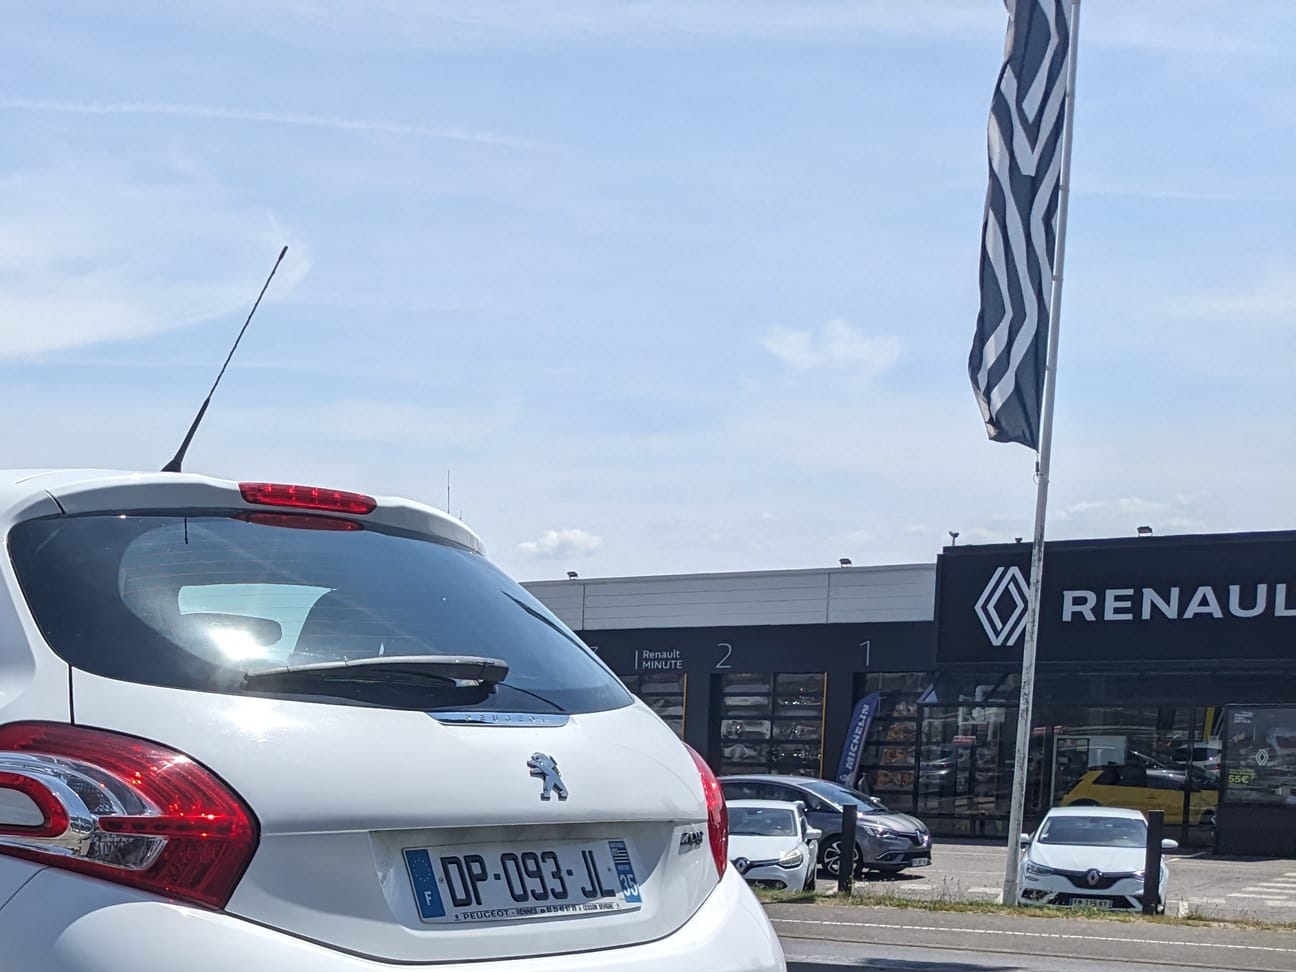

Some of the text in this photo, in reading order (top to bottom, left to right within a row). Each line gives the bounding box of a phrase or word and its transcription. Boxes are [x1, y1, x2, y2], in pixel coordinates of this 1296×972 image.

[642, 650, 680, 659] Renault
[716, 643, 732, 668] 2
[860, 640, 870, 666] 1
[642, 660, 683, 669] MINUTE
[845, 704, 870, 770] MICHELIN
[440, 850, 616, 907] DP-093-JL
[620, 874, 638, 896] 35
[424, 890, 432, 906] F
[463, 908, 509, 920] PEUGEOT
